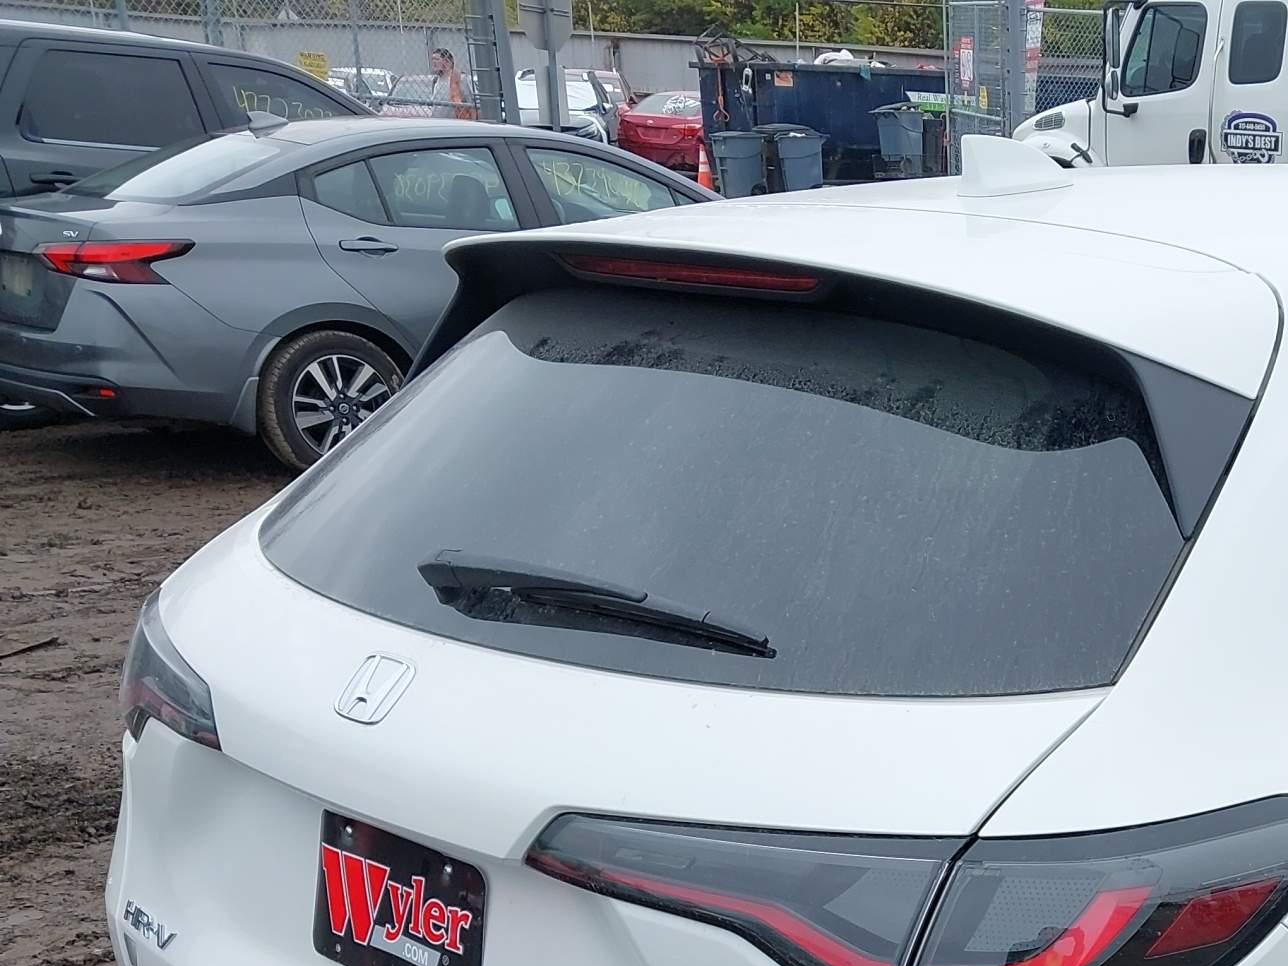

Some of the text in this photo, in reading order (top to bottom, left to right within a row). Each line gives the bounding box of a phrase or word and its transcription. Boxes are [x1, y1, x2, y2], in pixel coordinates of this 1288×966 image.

[1227, 134, 1277, 150] INDY'S BEST
[62, 230, 79, 239] SV
[320, 841, 473, 956] Wyler
